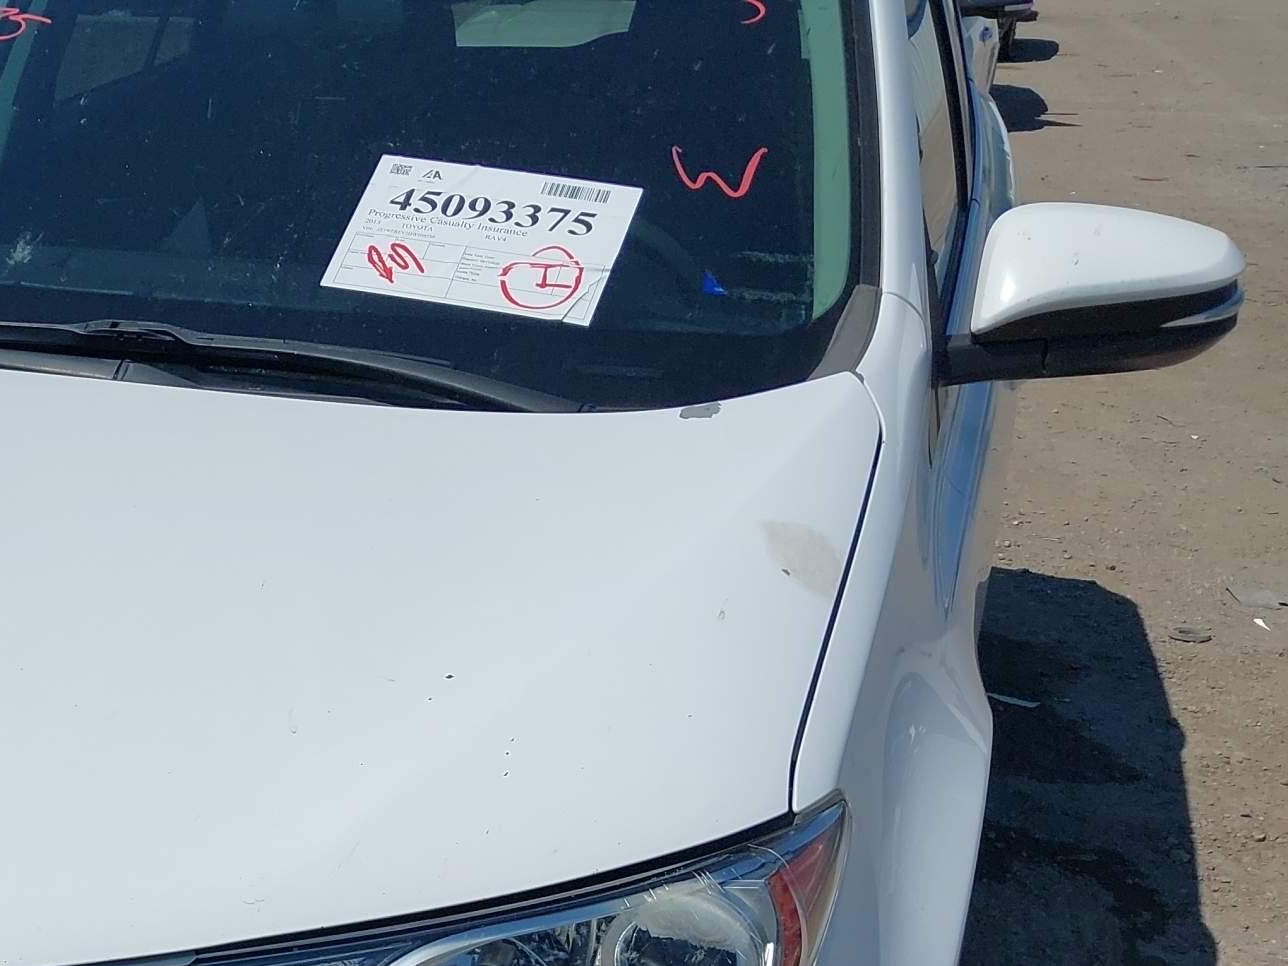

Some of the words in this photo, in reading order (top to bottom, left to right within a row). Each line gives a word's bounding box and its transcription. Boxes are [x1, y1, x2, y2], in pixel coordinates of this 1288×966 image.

[368, 208, 427, 223] Progressive
[429, 216, 475, 231] Casualty
[477, 222, 528, 238] Insurance
[389, 187, 598, 236] 45093375
